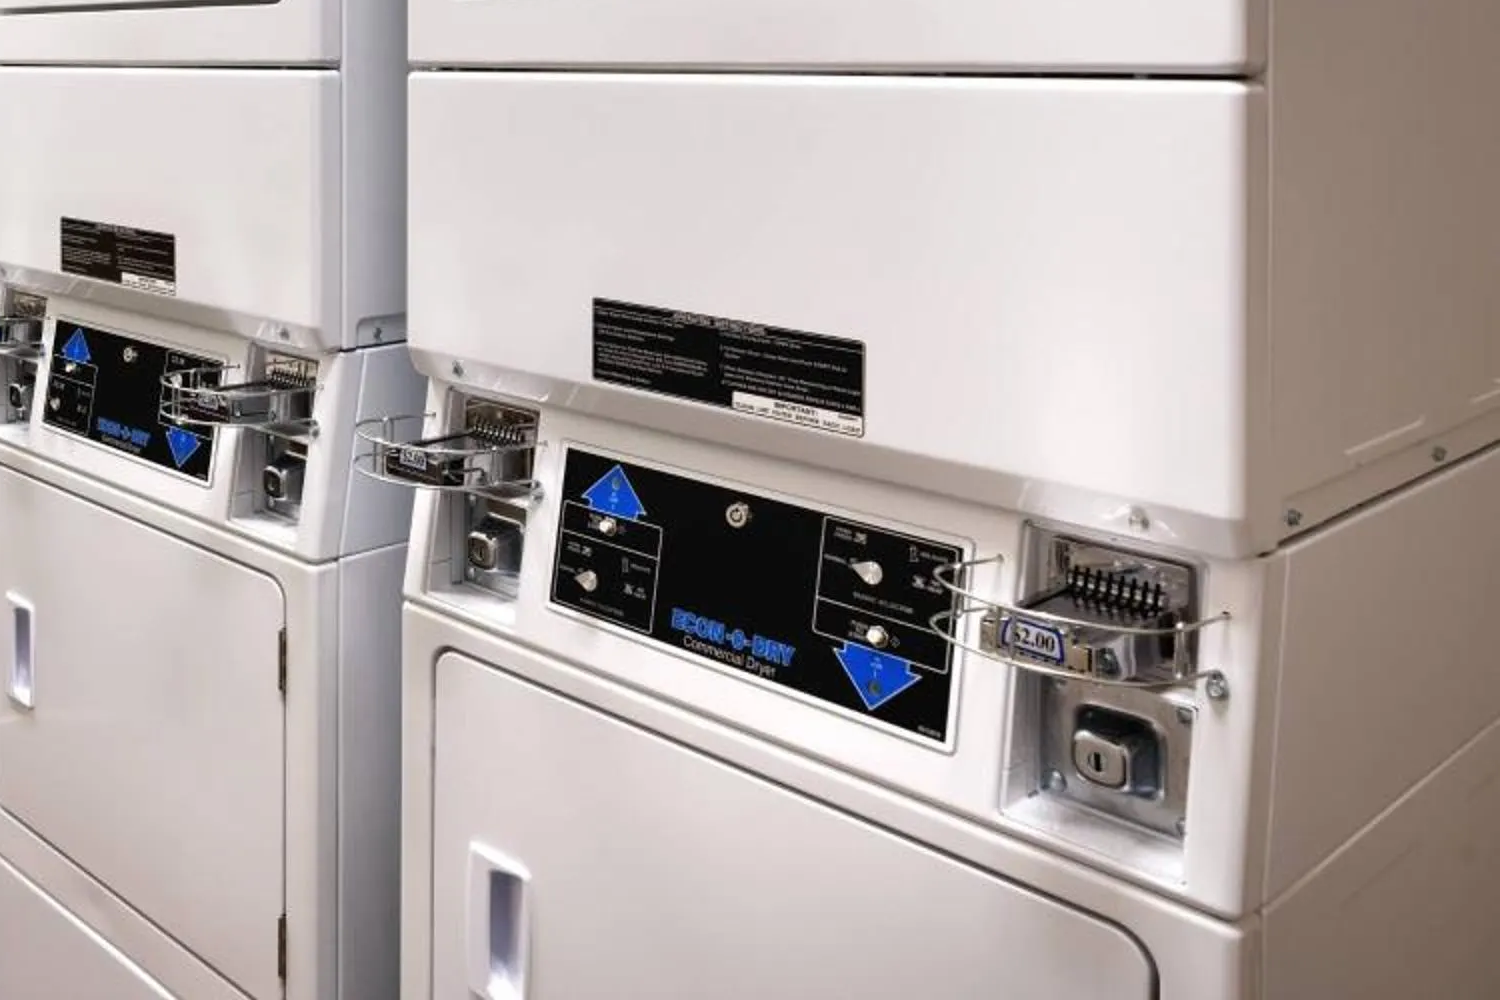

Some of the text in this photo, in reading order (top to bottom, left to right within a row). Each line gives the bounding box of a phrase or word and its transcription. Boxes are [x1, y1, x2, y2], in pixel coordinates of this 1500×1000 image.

[672, 607, 797, 667] ECON-O-DRY
[683, 635, 777, 678] Commercial Dryer
